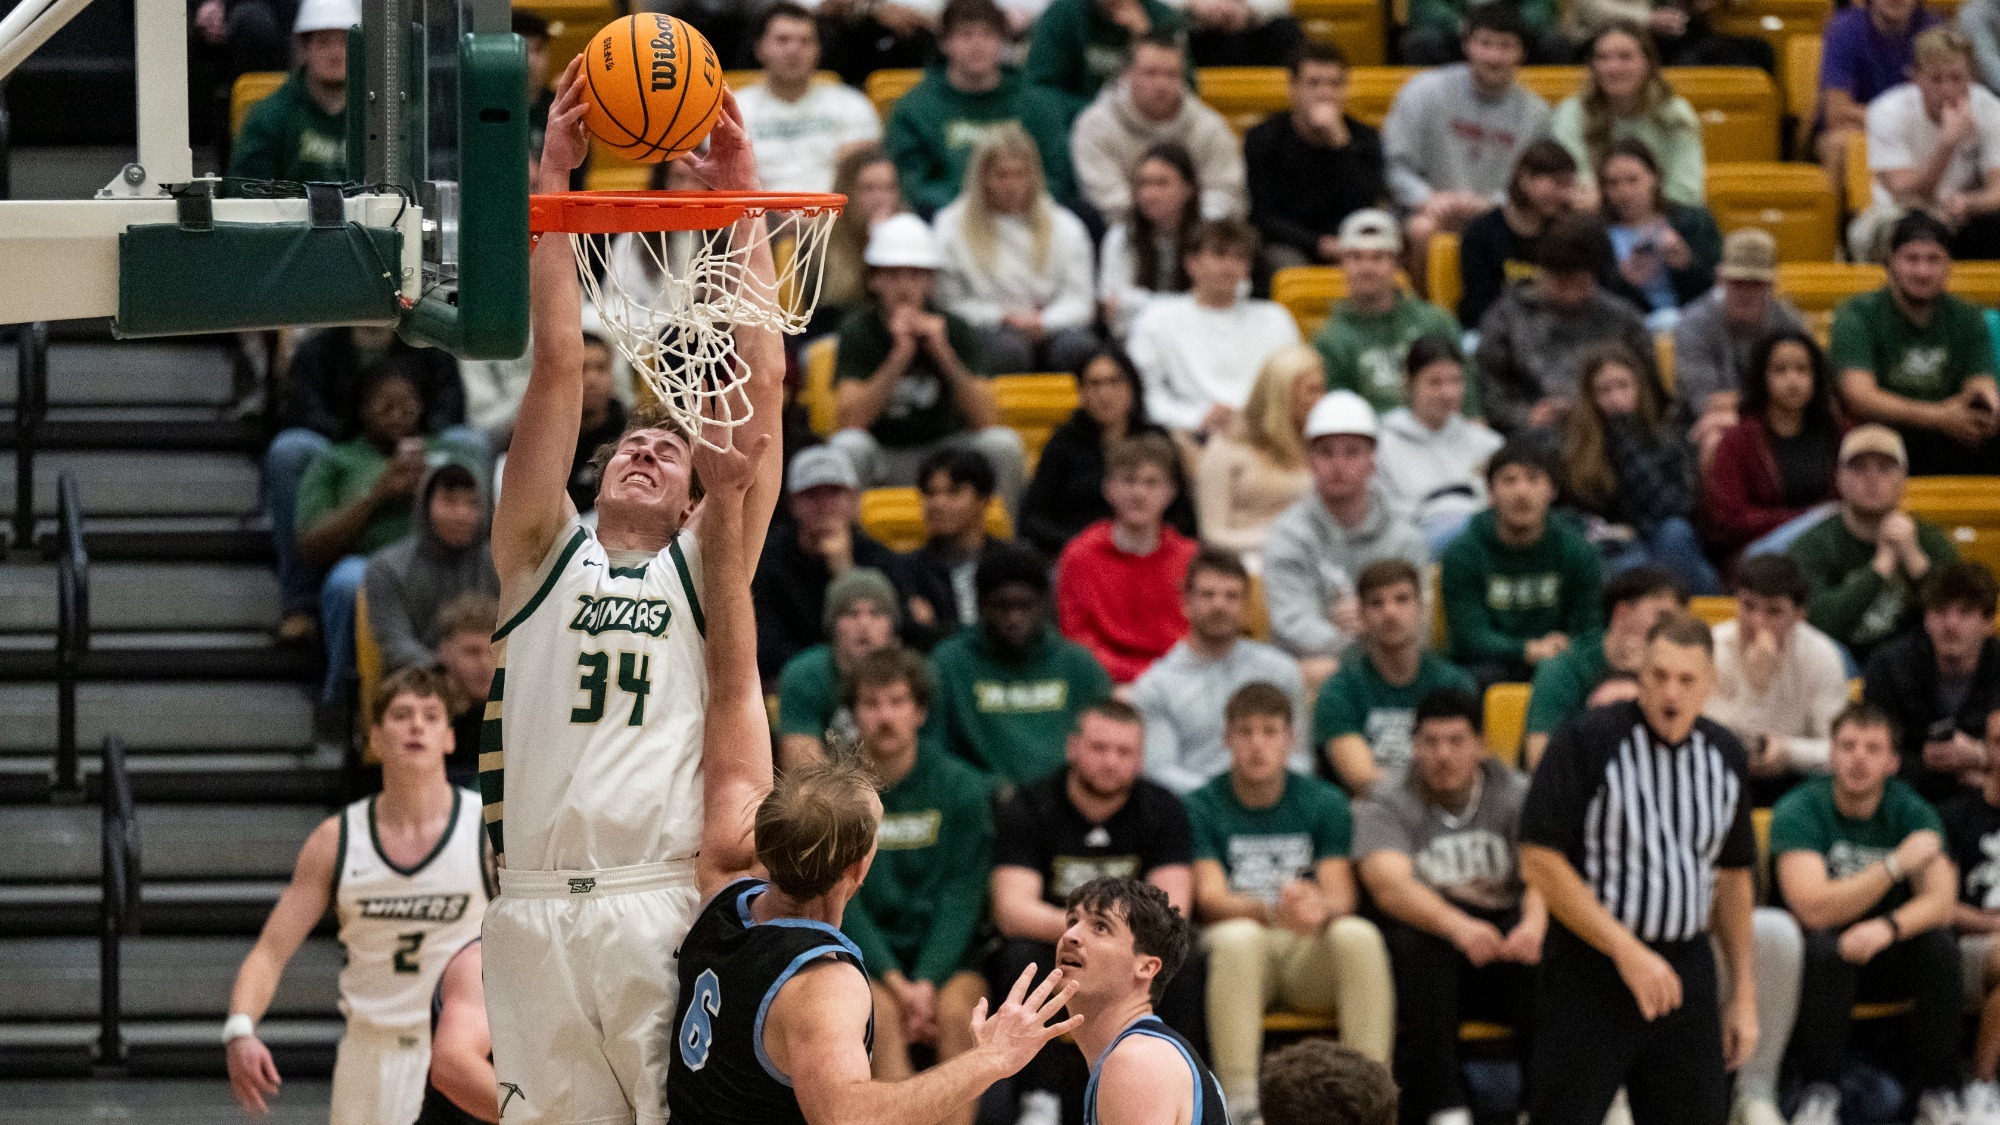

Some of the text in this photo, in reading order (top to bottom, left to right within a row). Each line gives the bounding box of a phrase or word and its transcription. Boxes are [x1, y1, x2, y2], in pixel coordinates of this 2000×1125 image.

[603, 36, 613, 63] NFHS
[650, 14, 677, 92] Wilson
[570, 650, 651, 727] 34
[361, 895, 467, 921] MINERS
[394, 932, 424, 973] 2
[679, 968, 721, 1072] 6
